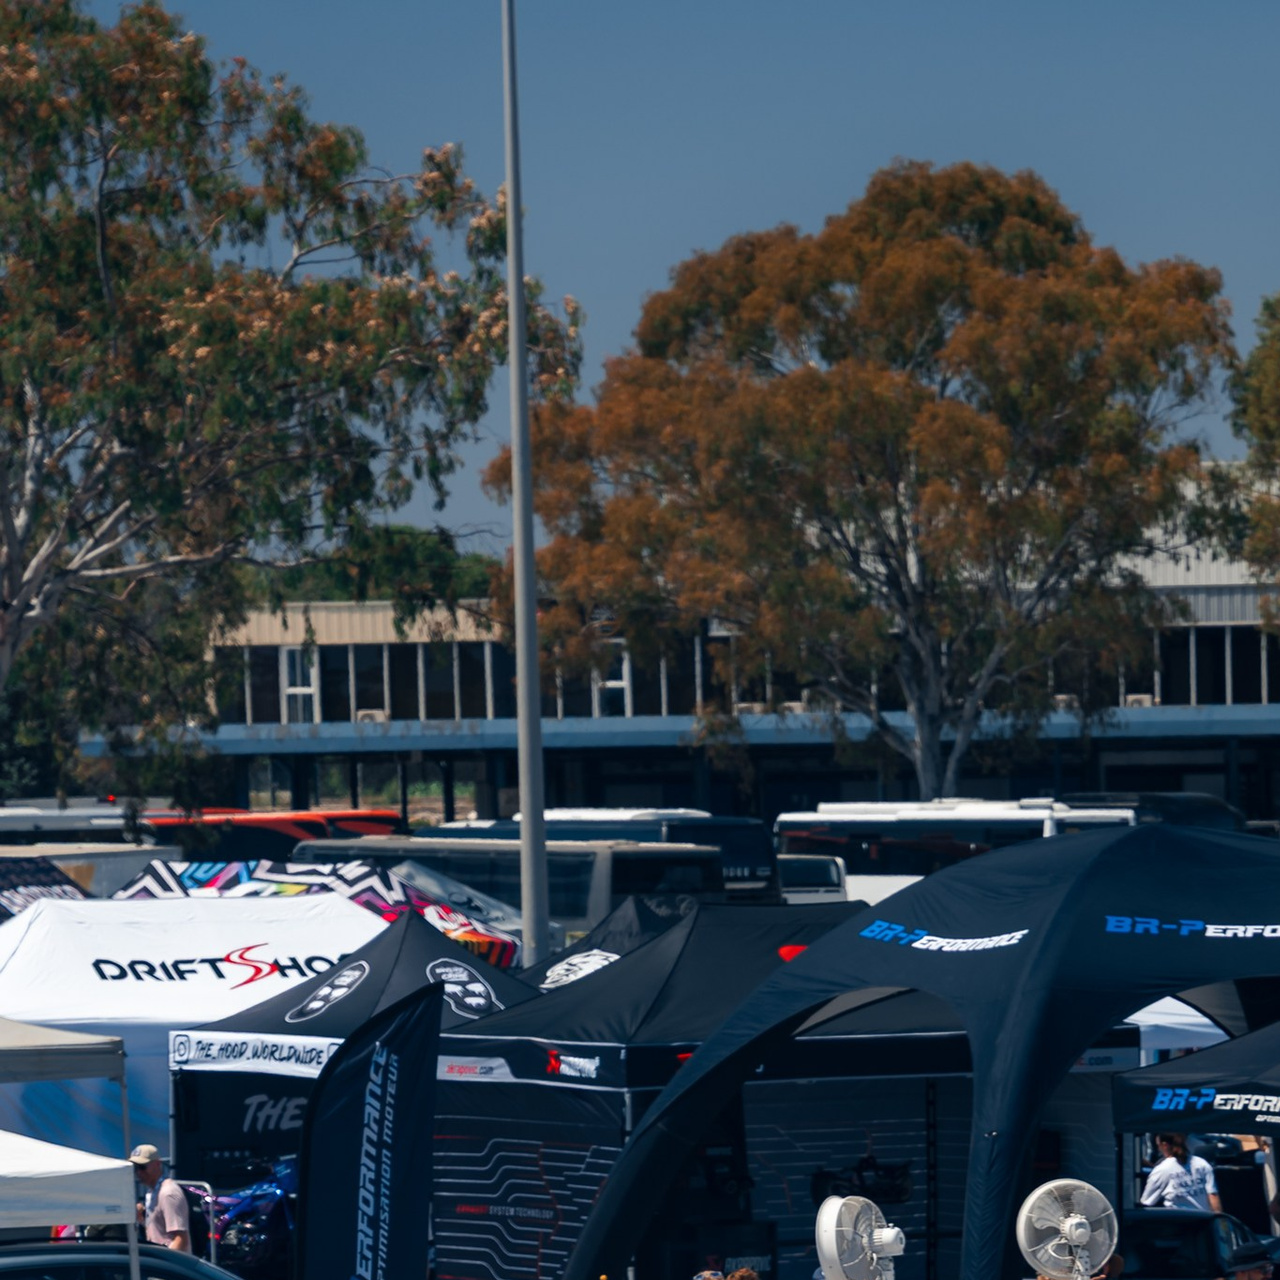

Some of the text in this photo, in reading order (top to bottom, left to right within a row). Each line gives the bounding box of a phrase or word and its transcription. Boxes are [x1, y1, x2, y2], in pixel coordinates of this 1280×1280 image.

[92, 942, 357, 989] DRIFTSHO
[243, 1094, 308, 1133] THE
[382, 1052, 399, 1144] MOTEUR
